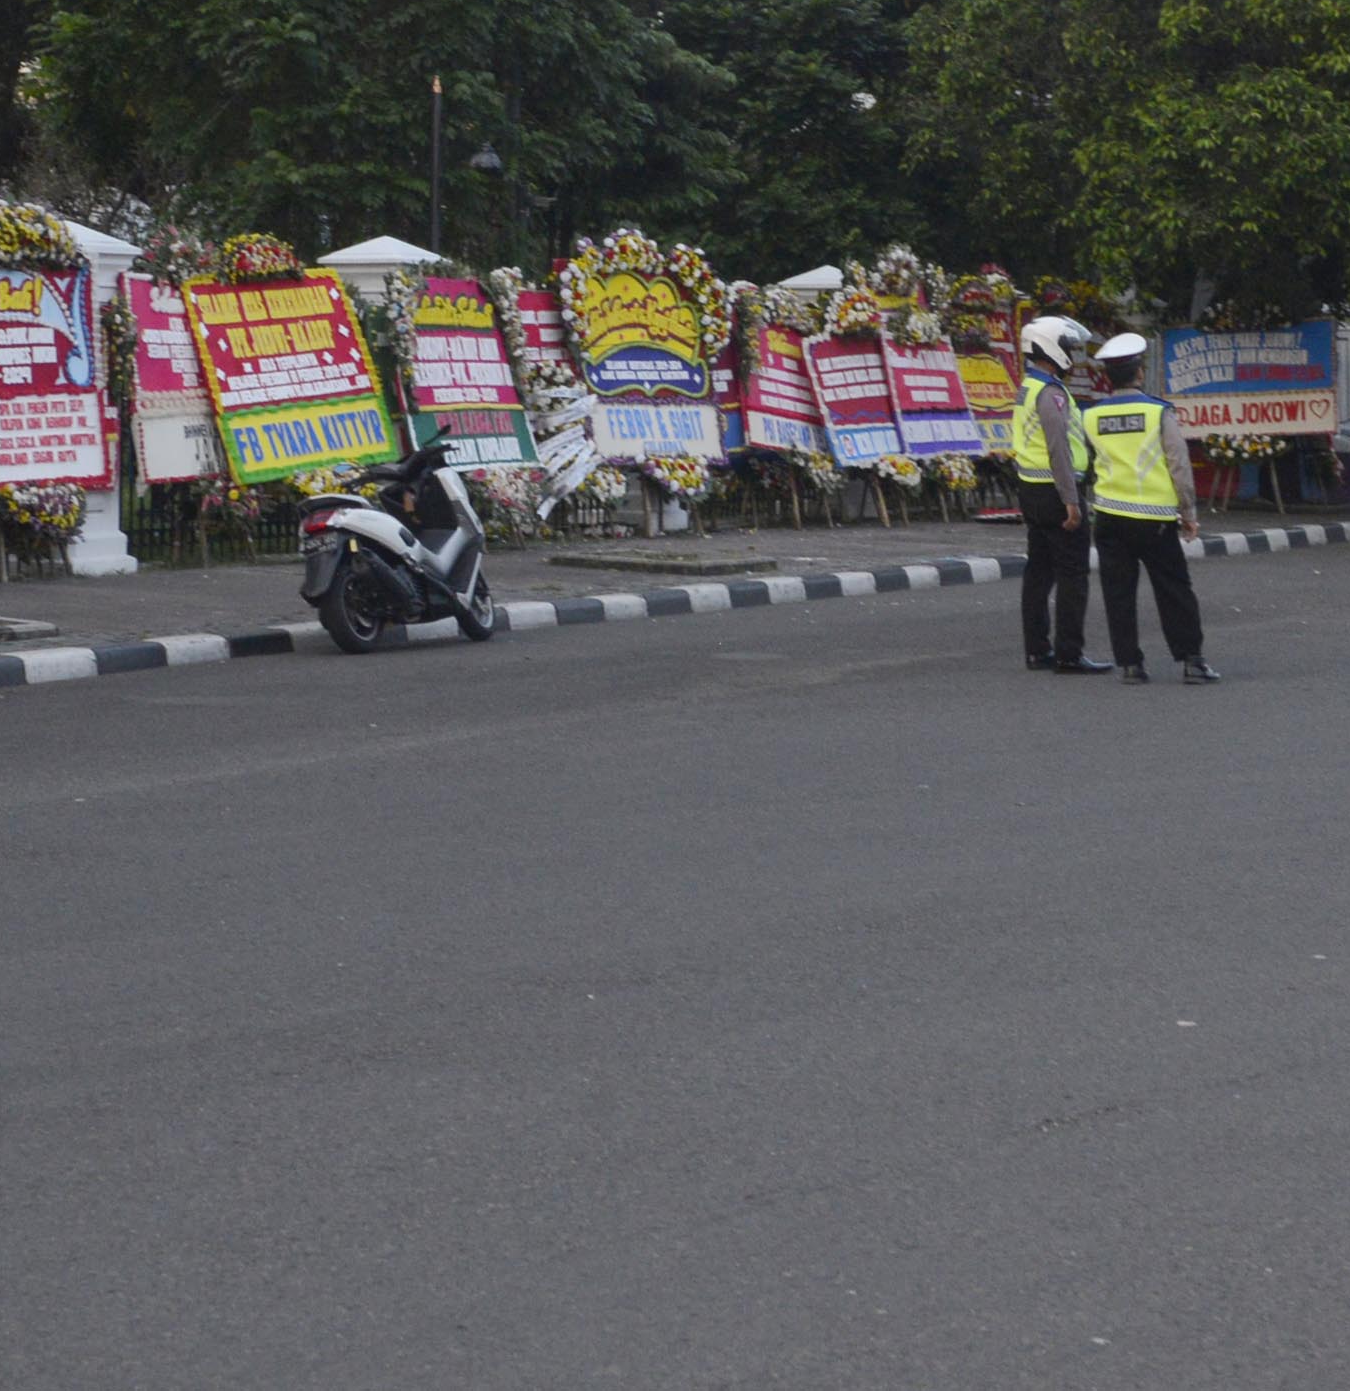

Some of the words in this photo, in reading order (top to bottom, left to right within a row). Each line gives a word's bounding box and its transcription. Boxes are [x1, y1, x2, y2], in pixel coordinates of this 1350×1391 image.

[606, 408, 652, 440] FEBBY
[669, 408, 706, 441] SIGIT
[1099, 415, 1145, 433] POLISI
[1236, 400, 1306, 425] JOKOWI
[232, 426, 264, 465] FB
[261, 418, 323, 460] TYARA
[318, 409, 386, 452] KITTYR
